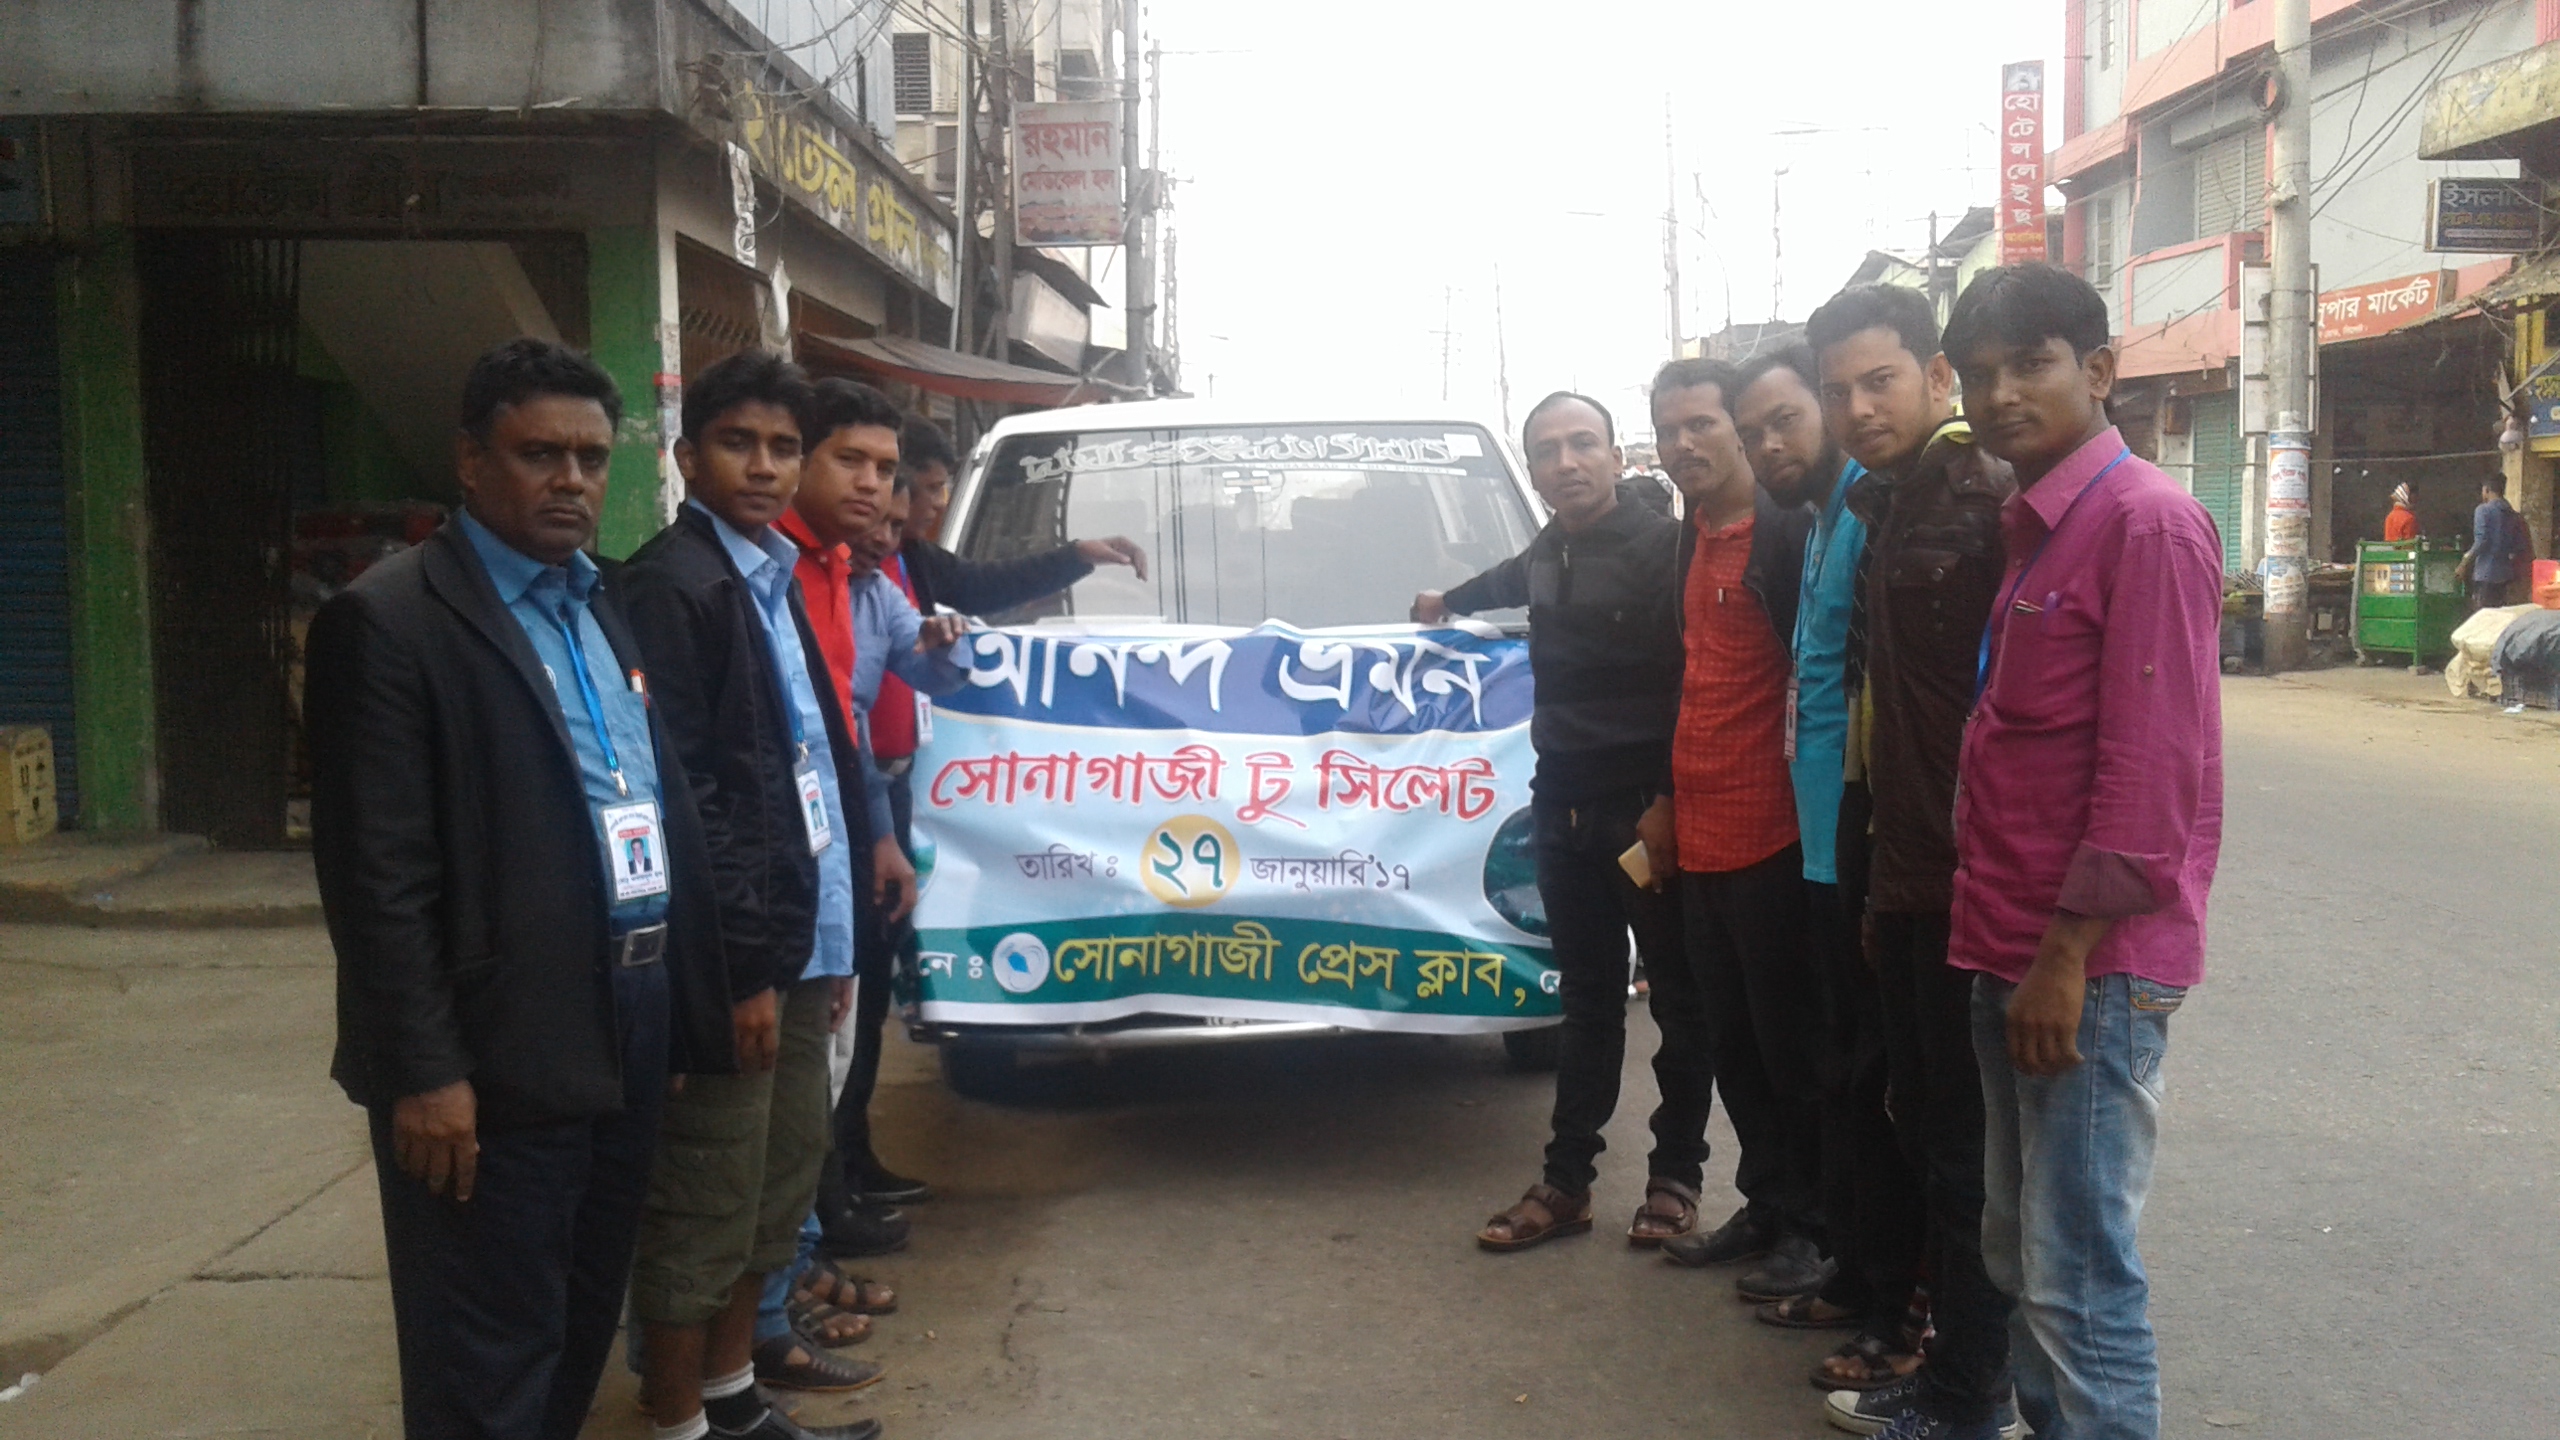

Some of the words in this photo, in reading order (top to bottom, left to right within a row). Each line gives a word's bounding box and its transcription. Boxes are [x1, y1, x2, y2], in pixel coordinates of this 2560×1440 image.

[1018, 119, 1112, 160] রহমান
[2004, 93, 2041, 160] হোটেল
[1091, 169, 1115, 190] হল
[2366, 276, 2432, 315] মার্কেট
[969, 634, 1233, 712] আনন্দ
[1279, 637, 1491, 726] ভ্রমন
[931, 745, 1226, 807] সোনাগাজী
[1236, 752, 1308, 827] টু
[1314, 750, 1496, 820] সিলেট
[1014, 844, 1099, 880] তারিখ
[1151, 832, 1224, 894] ২৭
[1053, 922, 1282, 984] সোনাগাজী
[1298, 939, 1400, 990] প্রেস
